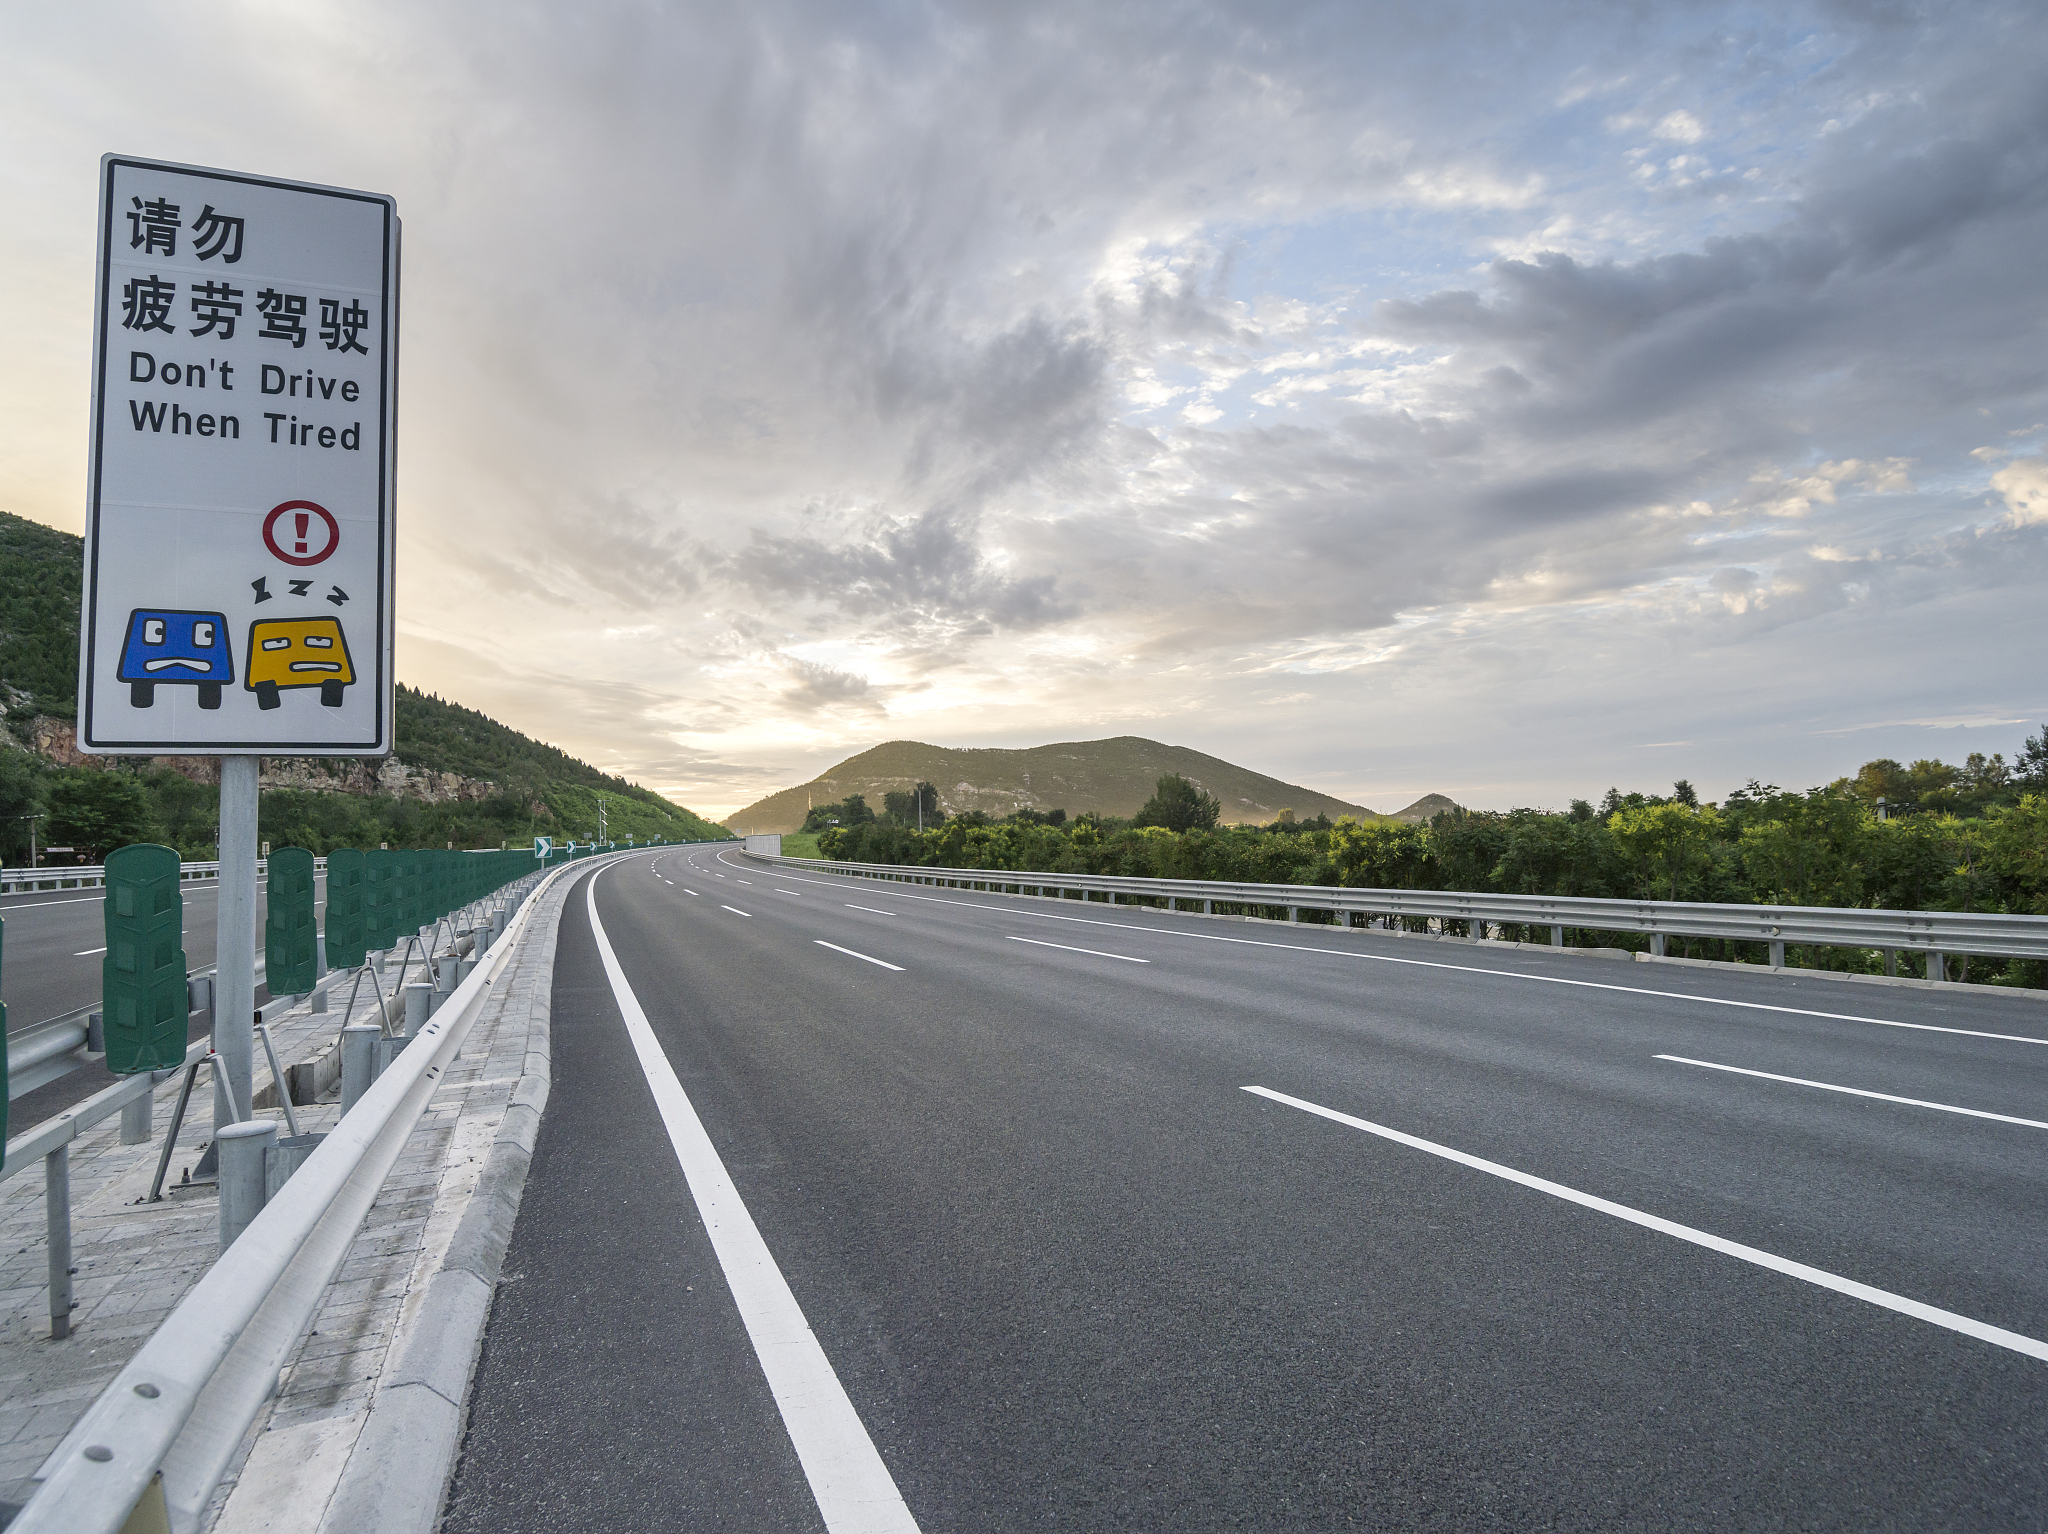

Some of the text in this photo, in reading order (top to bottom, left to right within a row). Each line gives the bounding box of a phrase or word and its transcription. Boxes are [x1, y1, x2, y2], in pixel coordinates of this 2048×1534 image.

[126, 196, 245, 264] 请勿
[121, 274, 369, 356] 疲劳驾驶
[129, 351, 360, 403] Don't Drive
[128, 399, 361, 451] When Tired
